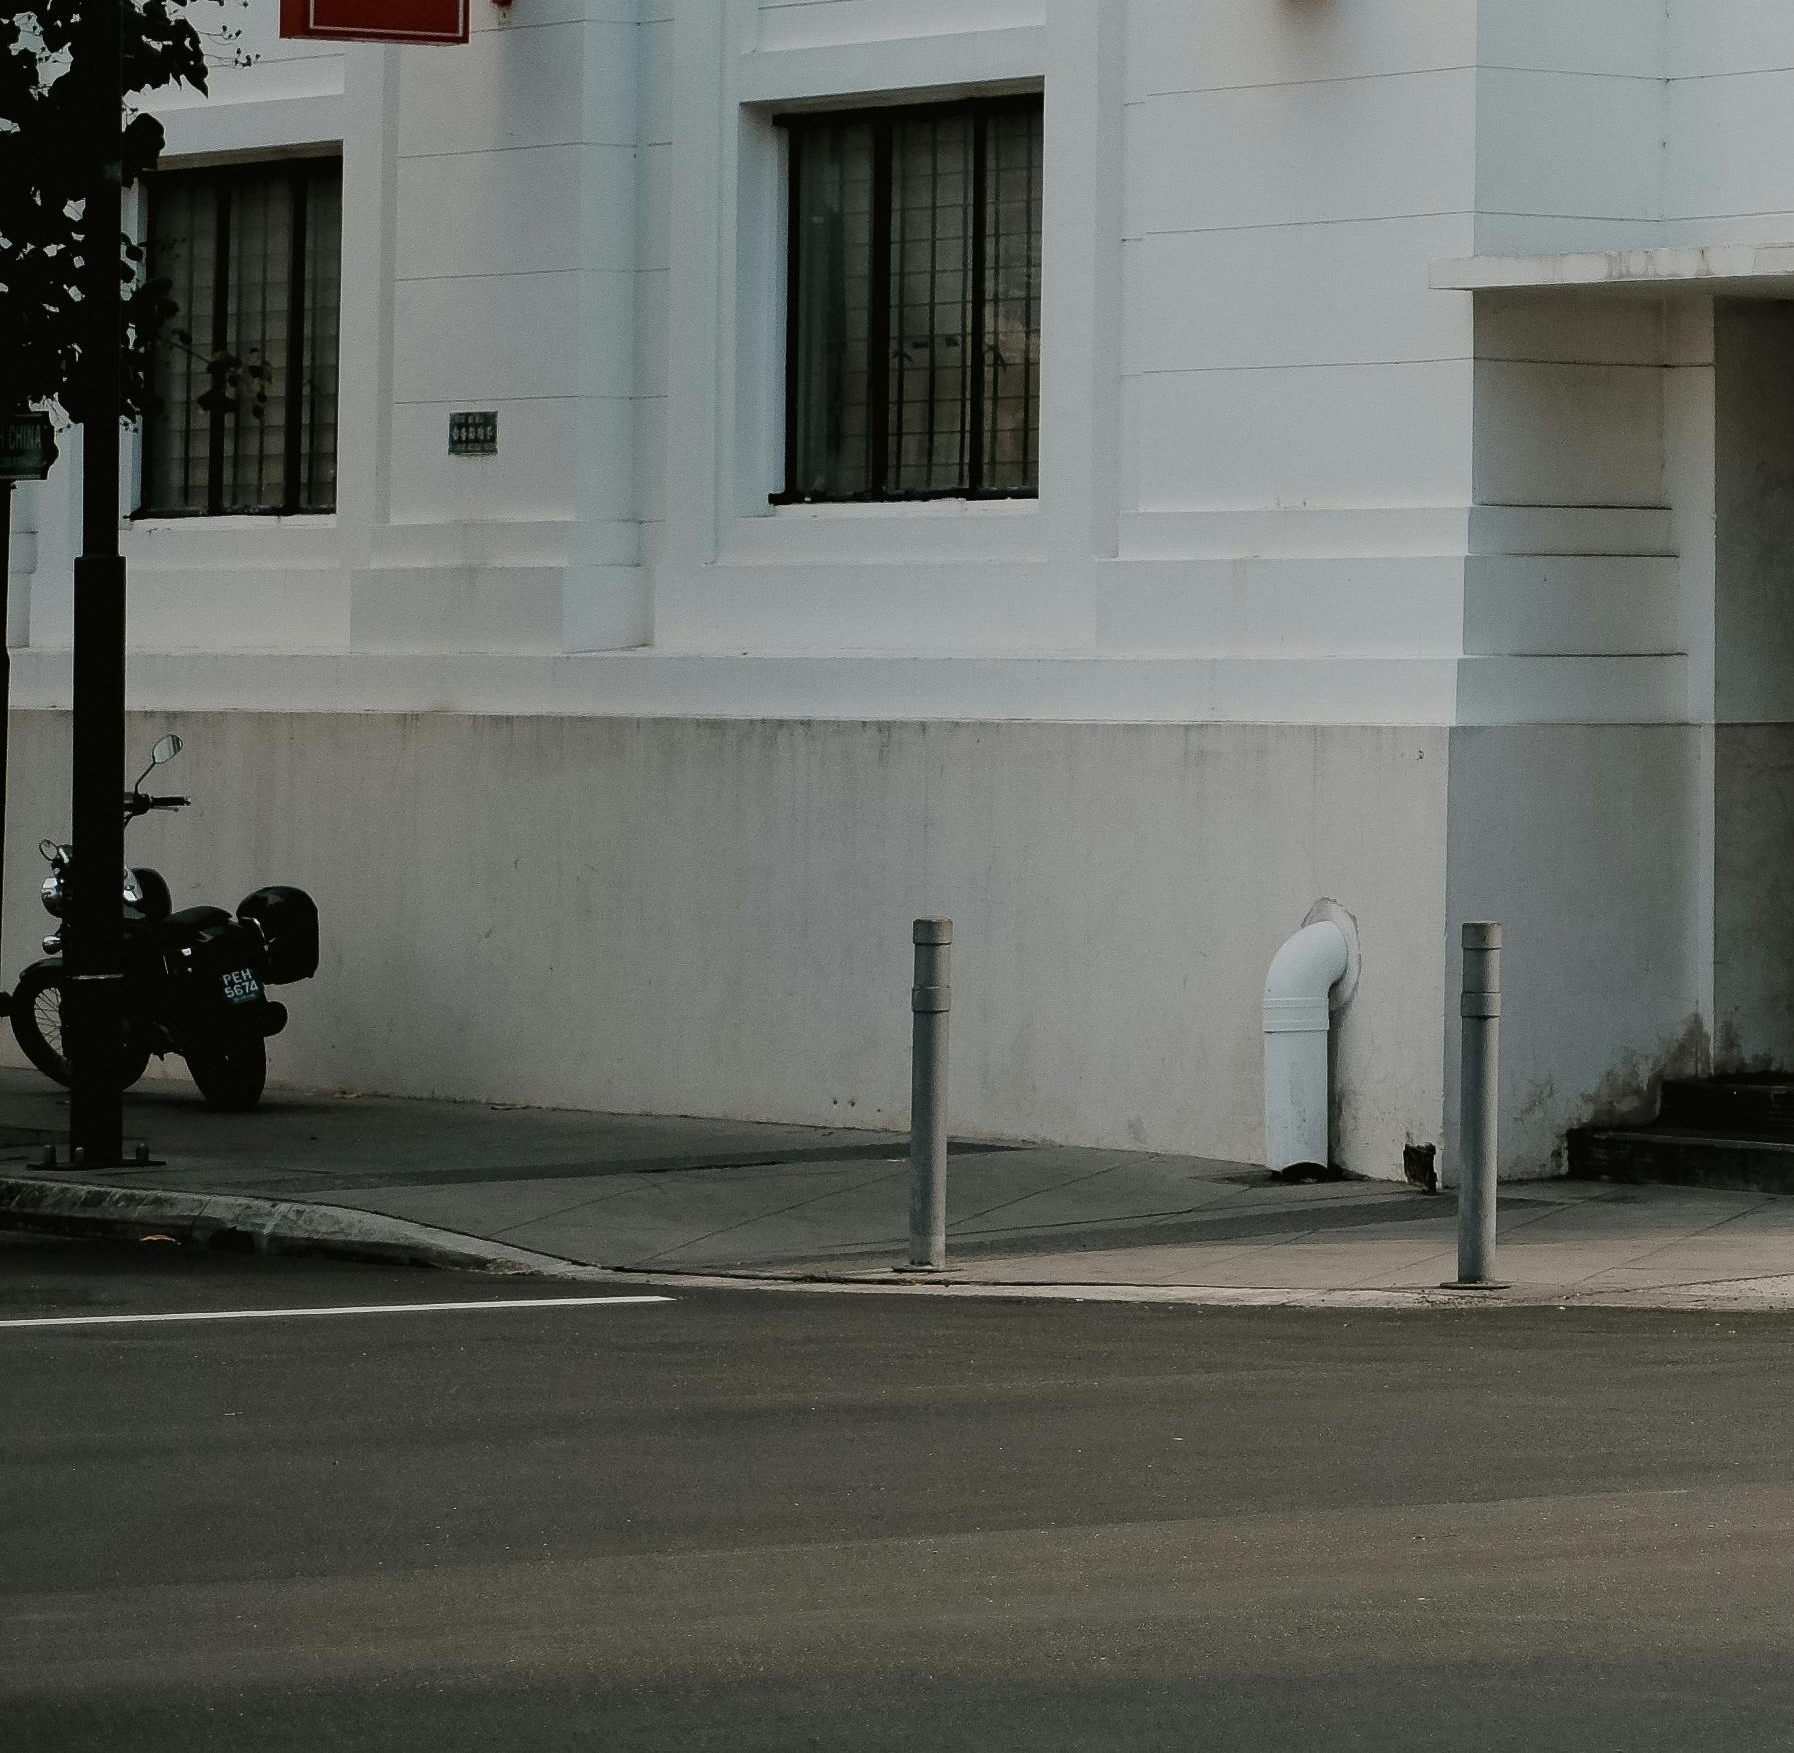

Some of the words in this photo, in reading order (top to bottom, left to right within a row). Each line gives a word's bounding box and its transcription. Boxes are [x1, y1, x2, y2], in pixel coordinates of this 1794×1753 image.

[9, 422, 42, 449] CHINA
[222, 967, 252, 986] PEH
[224, 979, 259, 998] 5674
